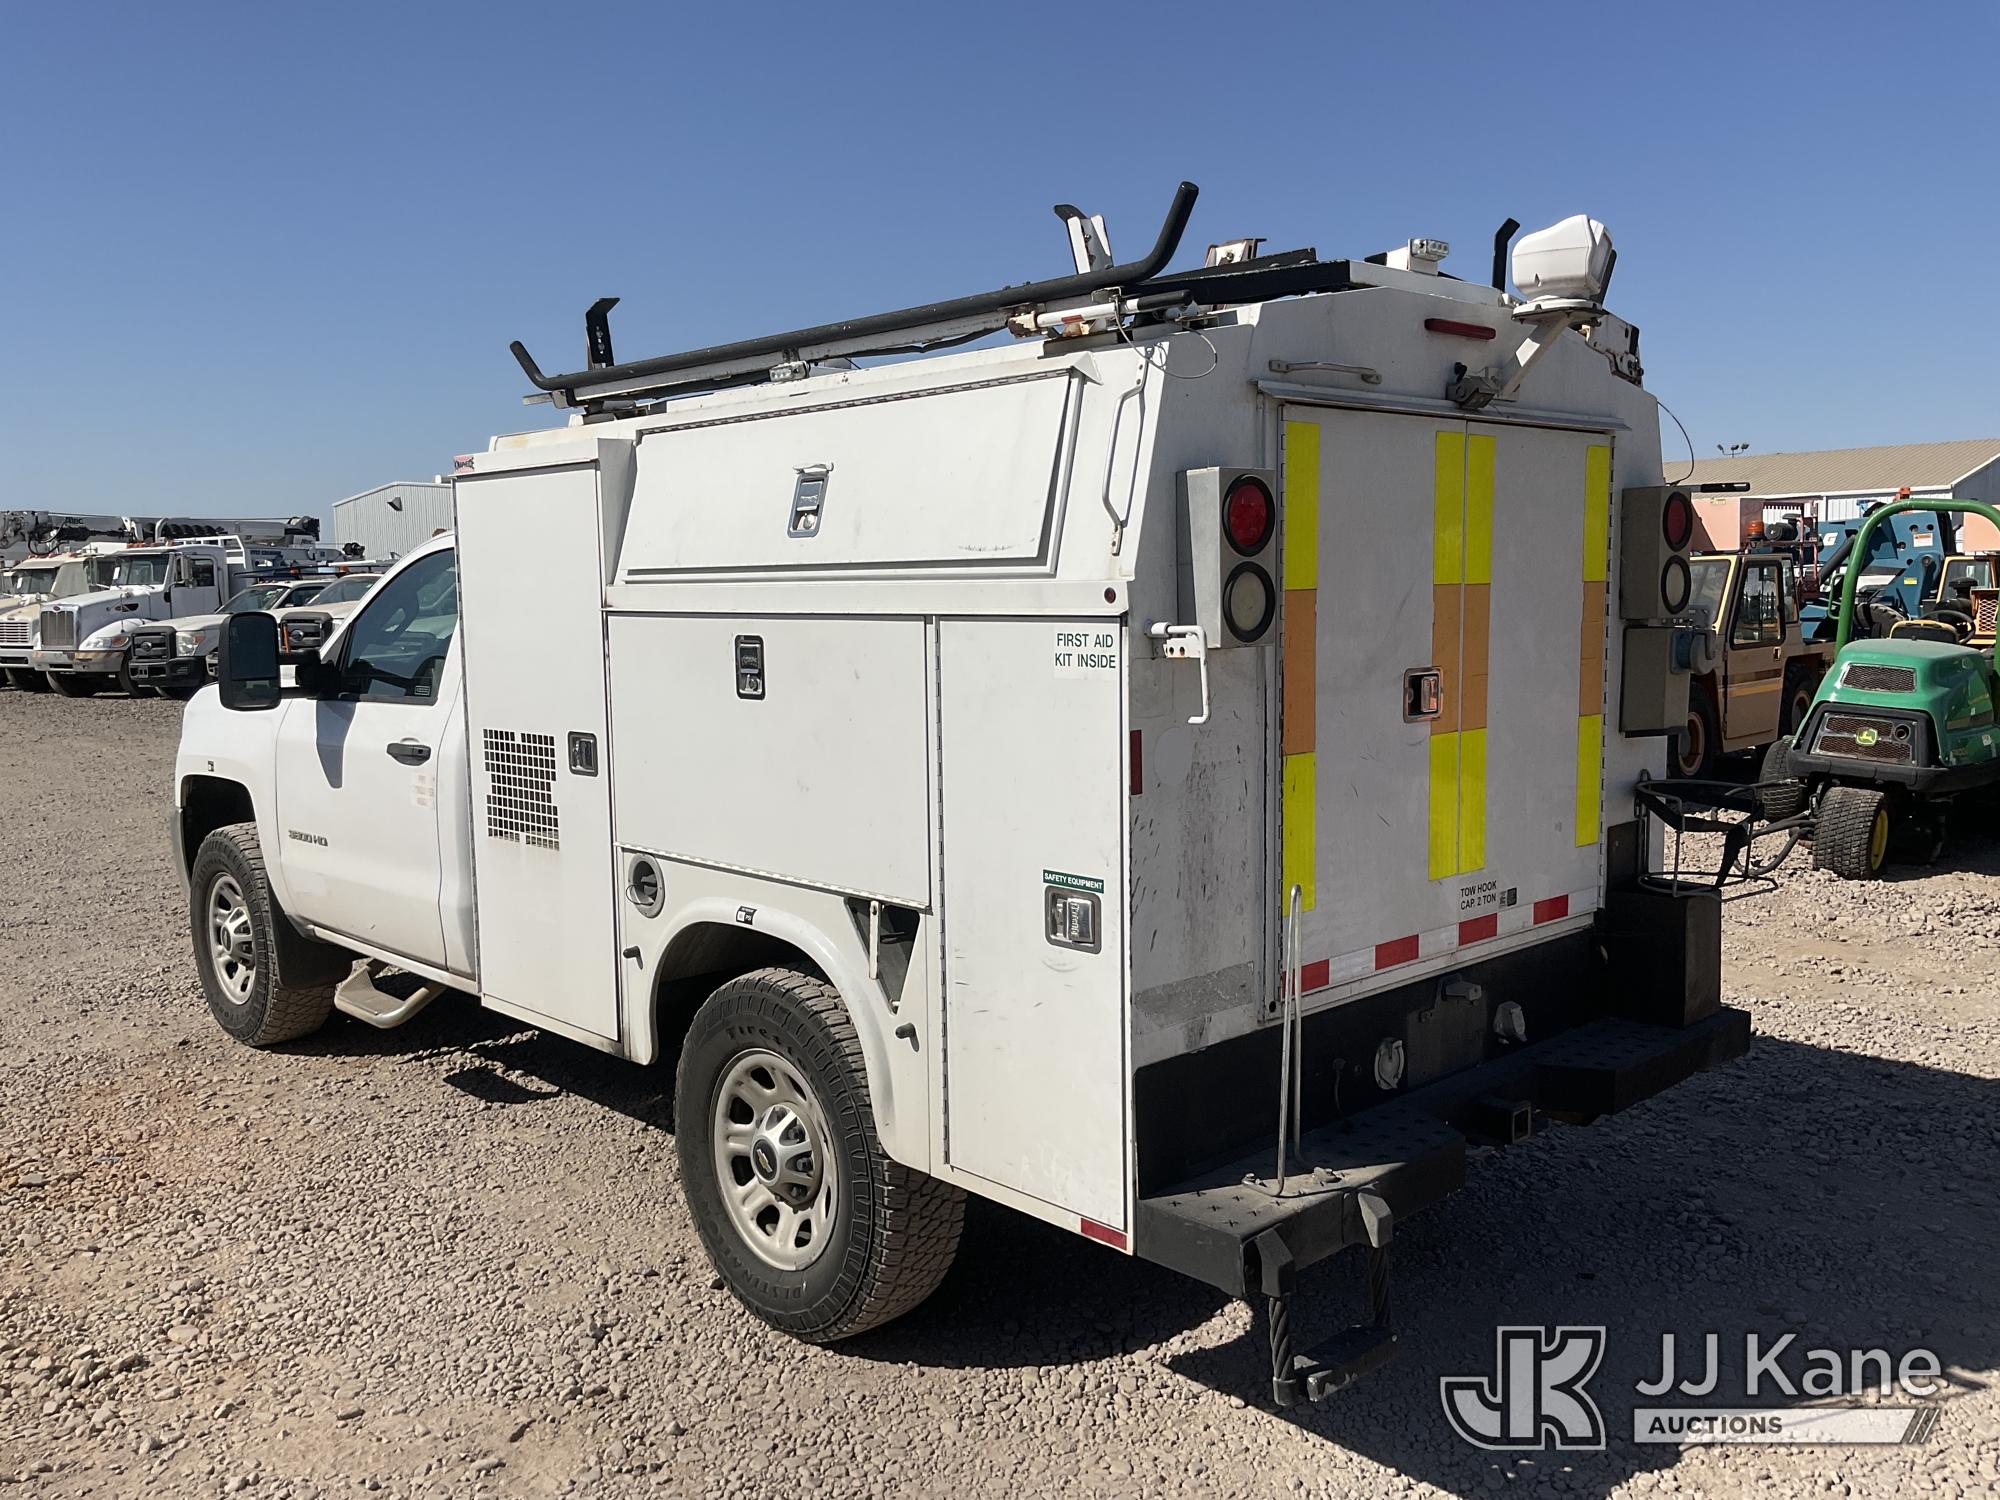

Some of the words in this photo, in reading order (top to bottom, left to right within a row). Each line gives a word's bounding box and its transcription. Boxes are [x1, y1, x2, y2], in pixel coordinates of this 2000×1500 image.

[1057, 633, 1089, 647] FIRST
[1094, 634, 1114, 647] AID
[1055, 653, 1072, 666] KIT
[1077, 653, 1116, 668] INSIDE
[1044, 873, 1067, 883] SAFETY
[1067, 877, 1102, 889] EQUIPMENT
[1460, 885, 1476, 897] TOW
[1477, 880, 1497, 893] HOOK
[1477, 896, 1482, 906] 2
[1483, 893, 1497, 905] TON
